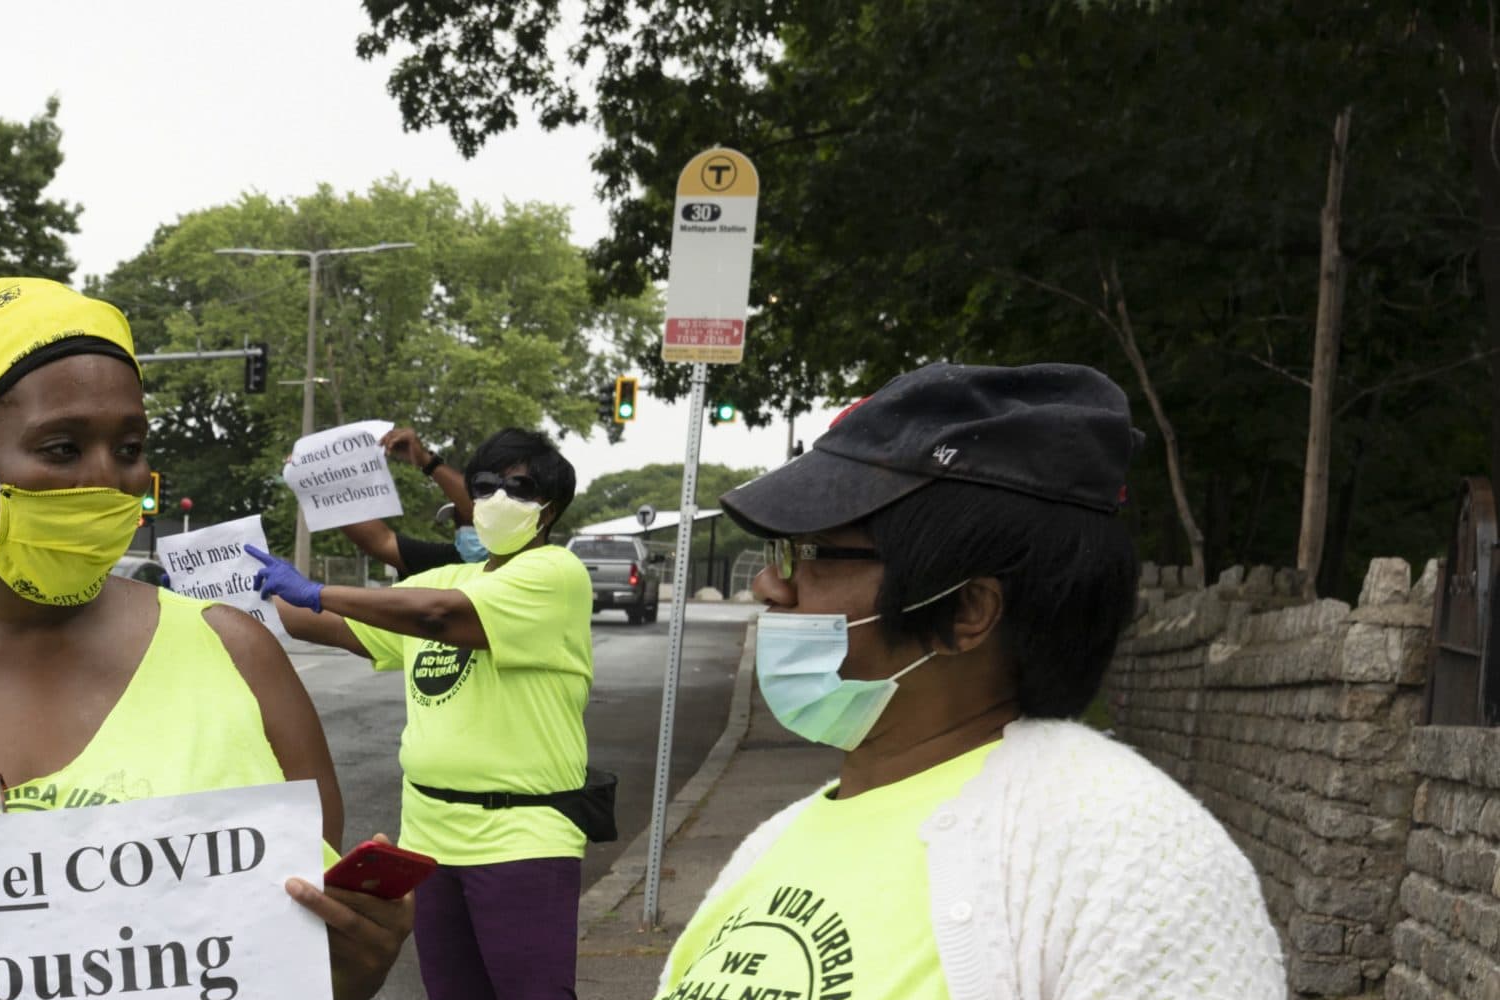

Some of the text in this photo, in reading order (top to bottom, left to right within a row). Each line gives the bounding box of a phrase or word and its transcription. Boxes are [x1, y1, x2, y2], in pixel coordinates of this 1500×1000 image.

[708, 165, 731, 185] T
[311, 484, 390, 509] Foreclosures
[167, 543, 242, 575] Fight mass
[175, 572, 257, 600] ictions afte
[65, 826, 266, 893] COVID
[768, 886, 825, 927] VIDA
[720, 951, 768, 976] WE
